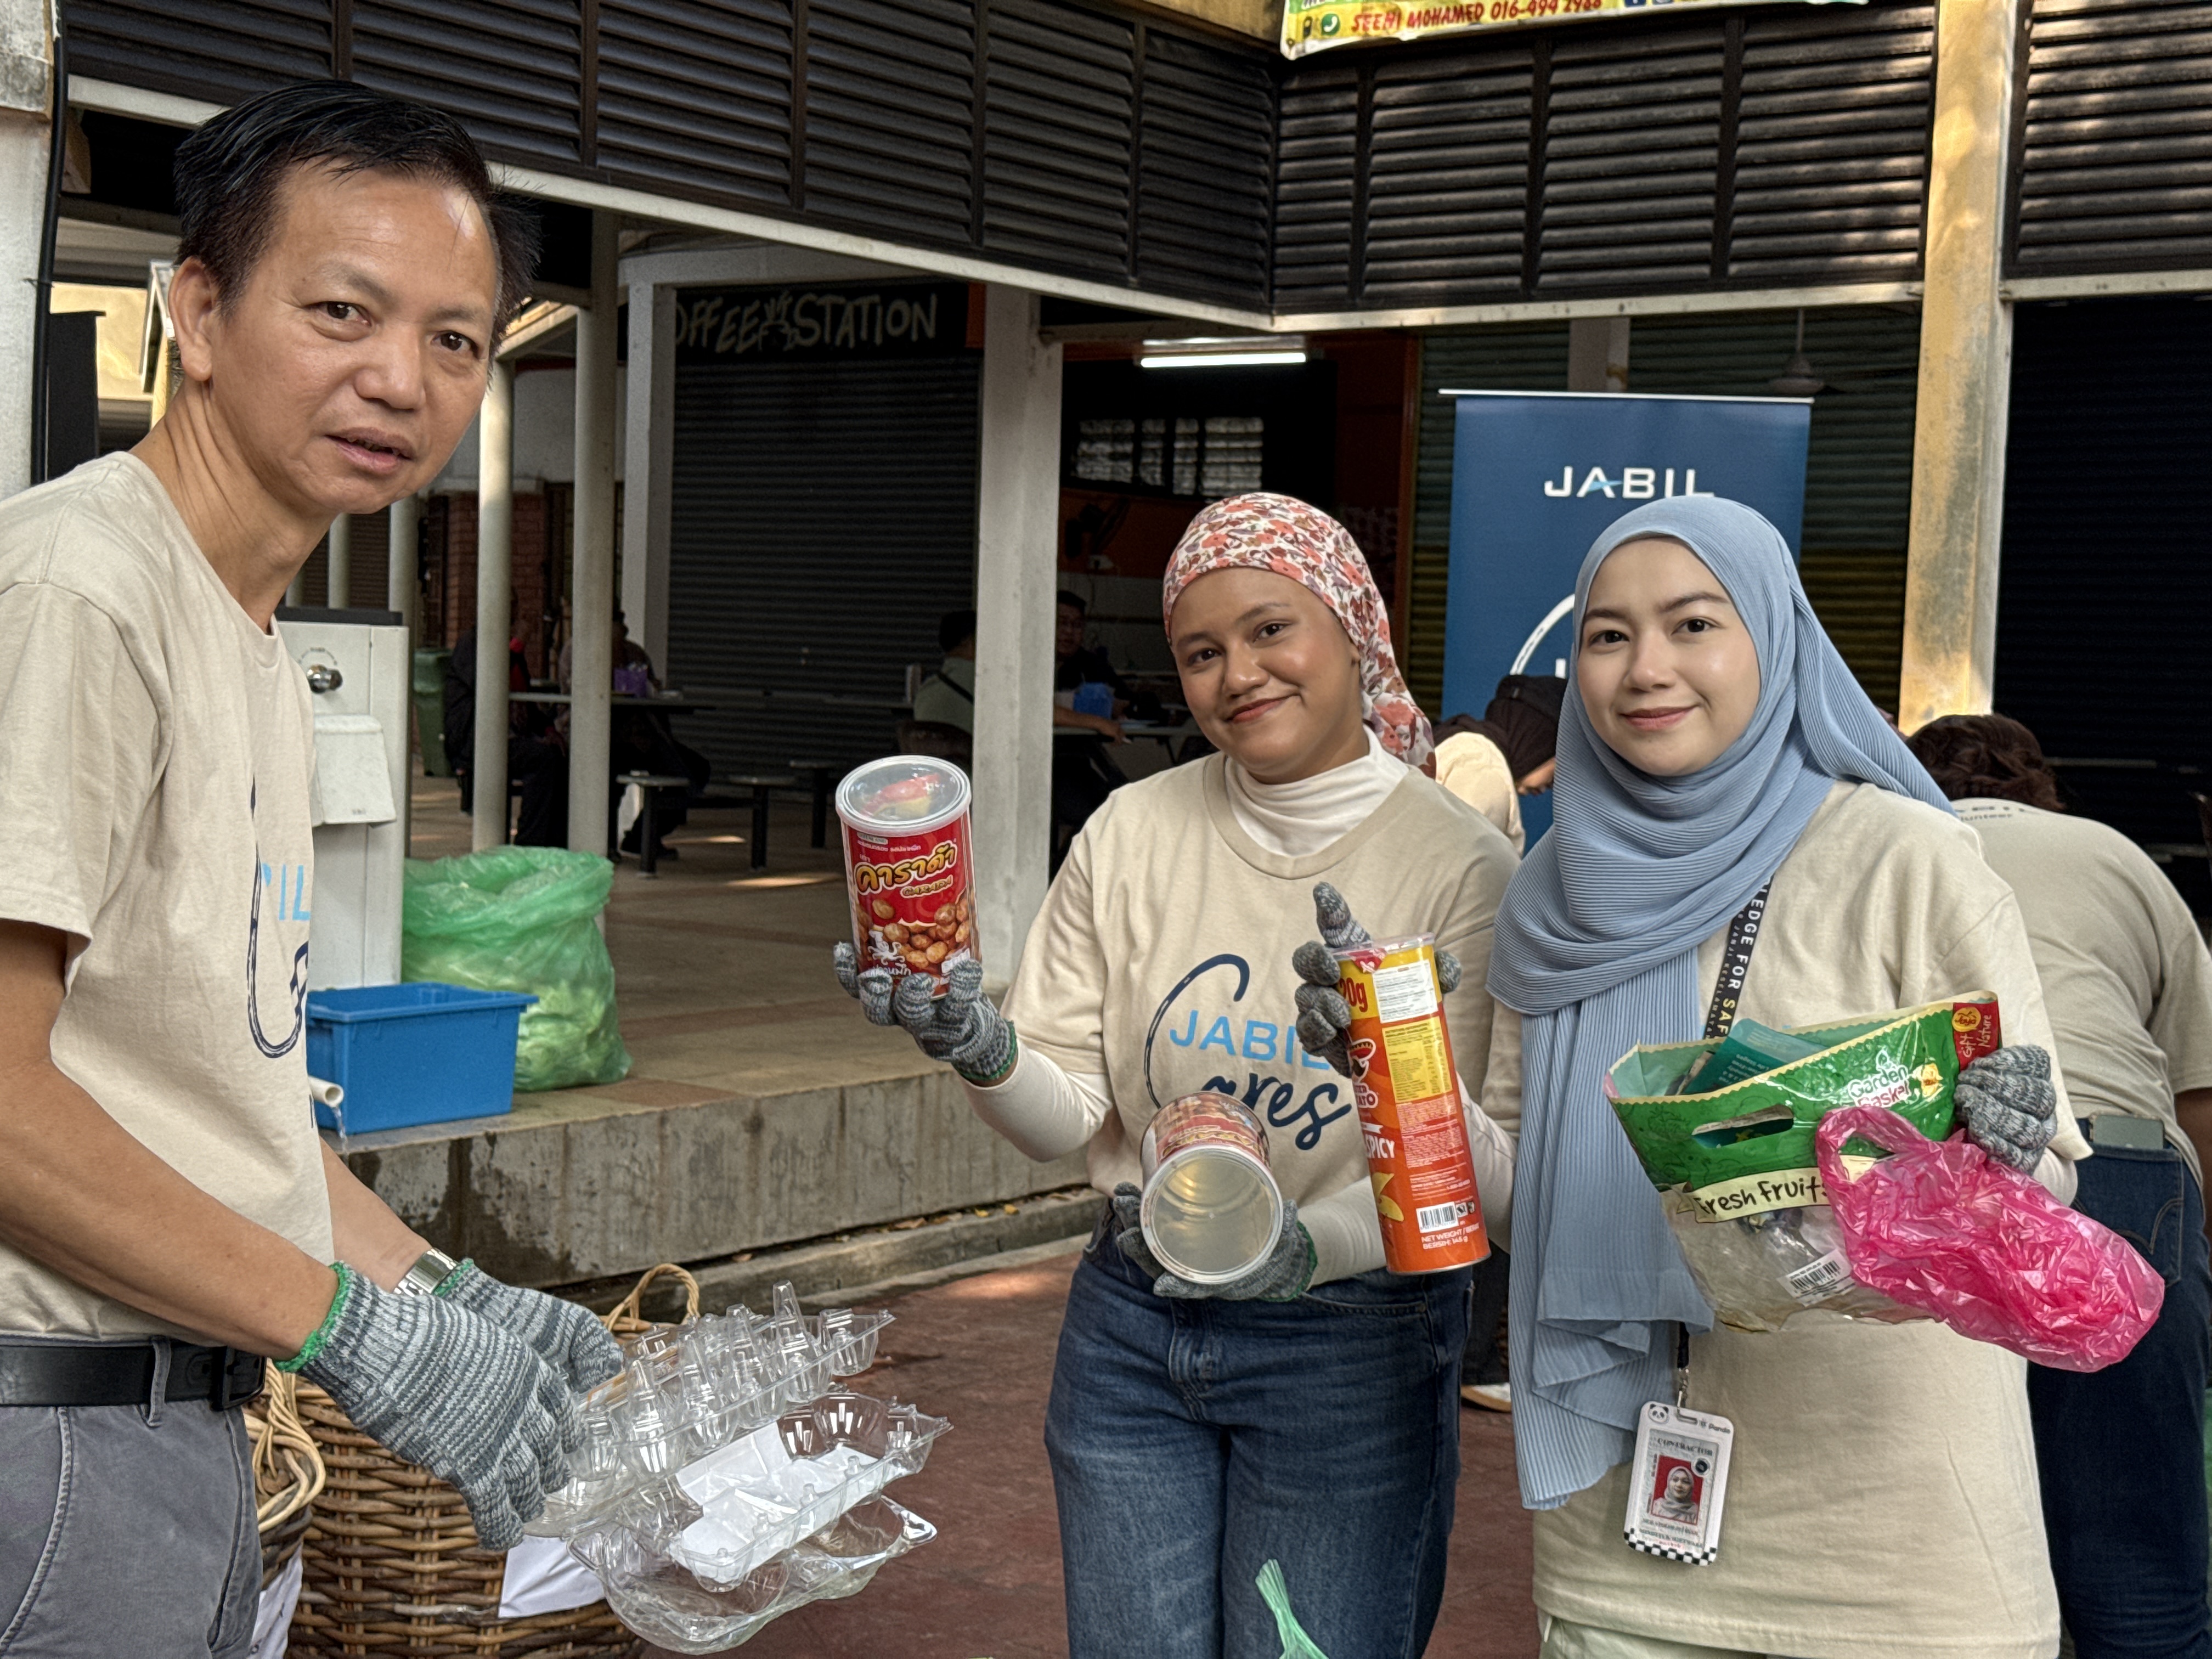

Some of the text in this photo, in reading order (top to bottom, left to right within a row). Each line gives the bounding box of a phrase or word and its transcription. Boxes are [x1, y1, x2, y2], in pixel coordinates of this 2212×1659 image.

[1406, 3, 1484, 29] MOHAMED
[793, 293, 938, 349] STATION
[1544, 466, 1715, 499] JABIL
[1728, 953, 1748, 990] FOR
[1714, 997, 1736, 1038] SAF
[1976, 1014, 1992, 1048] Nature
[1849, 1066, 1909, 1097] Garden
